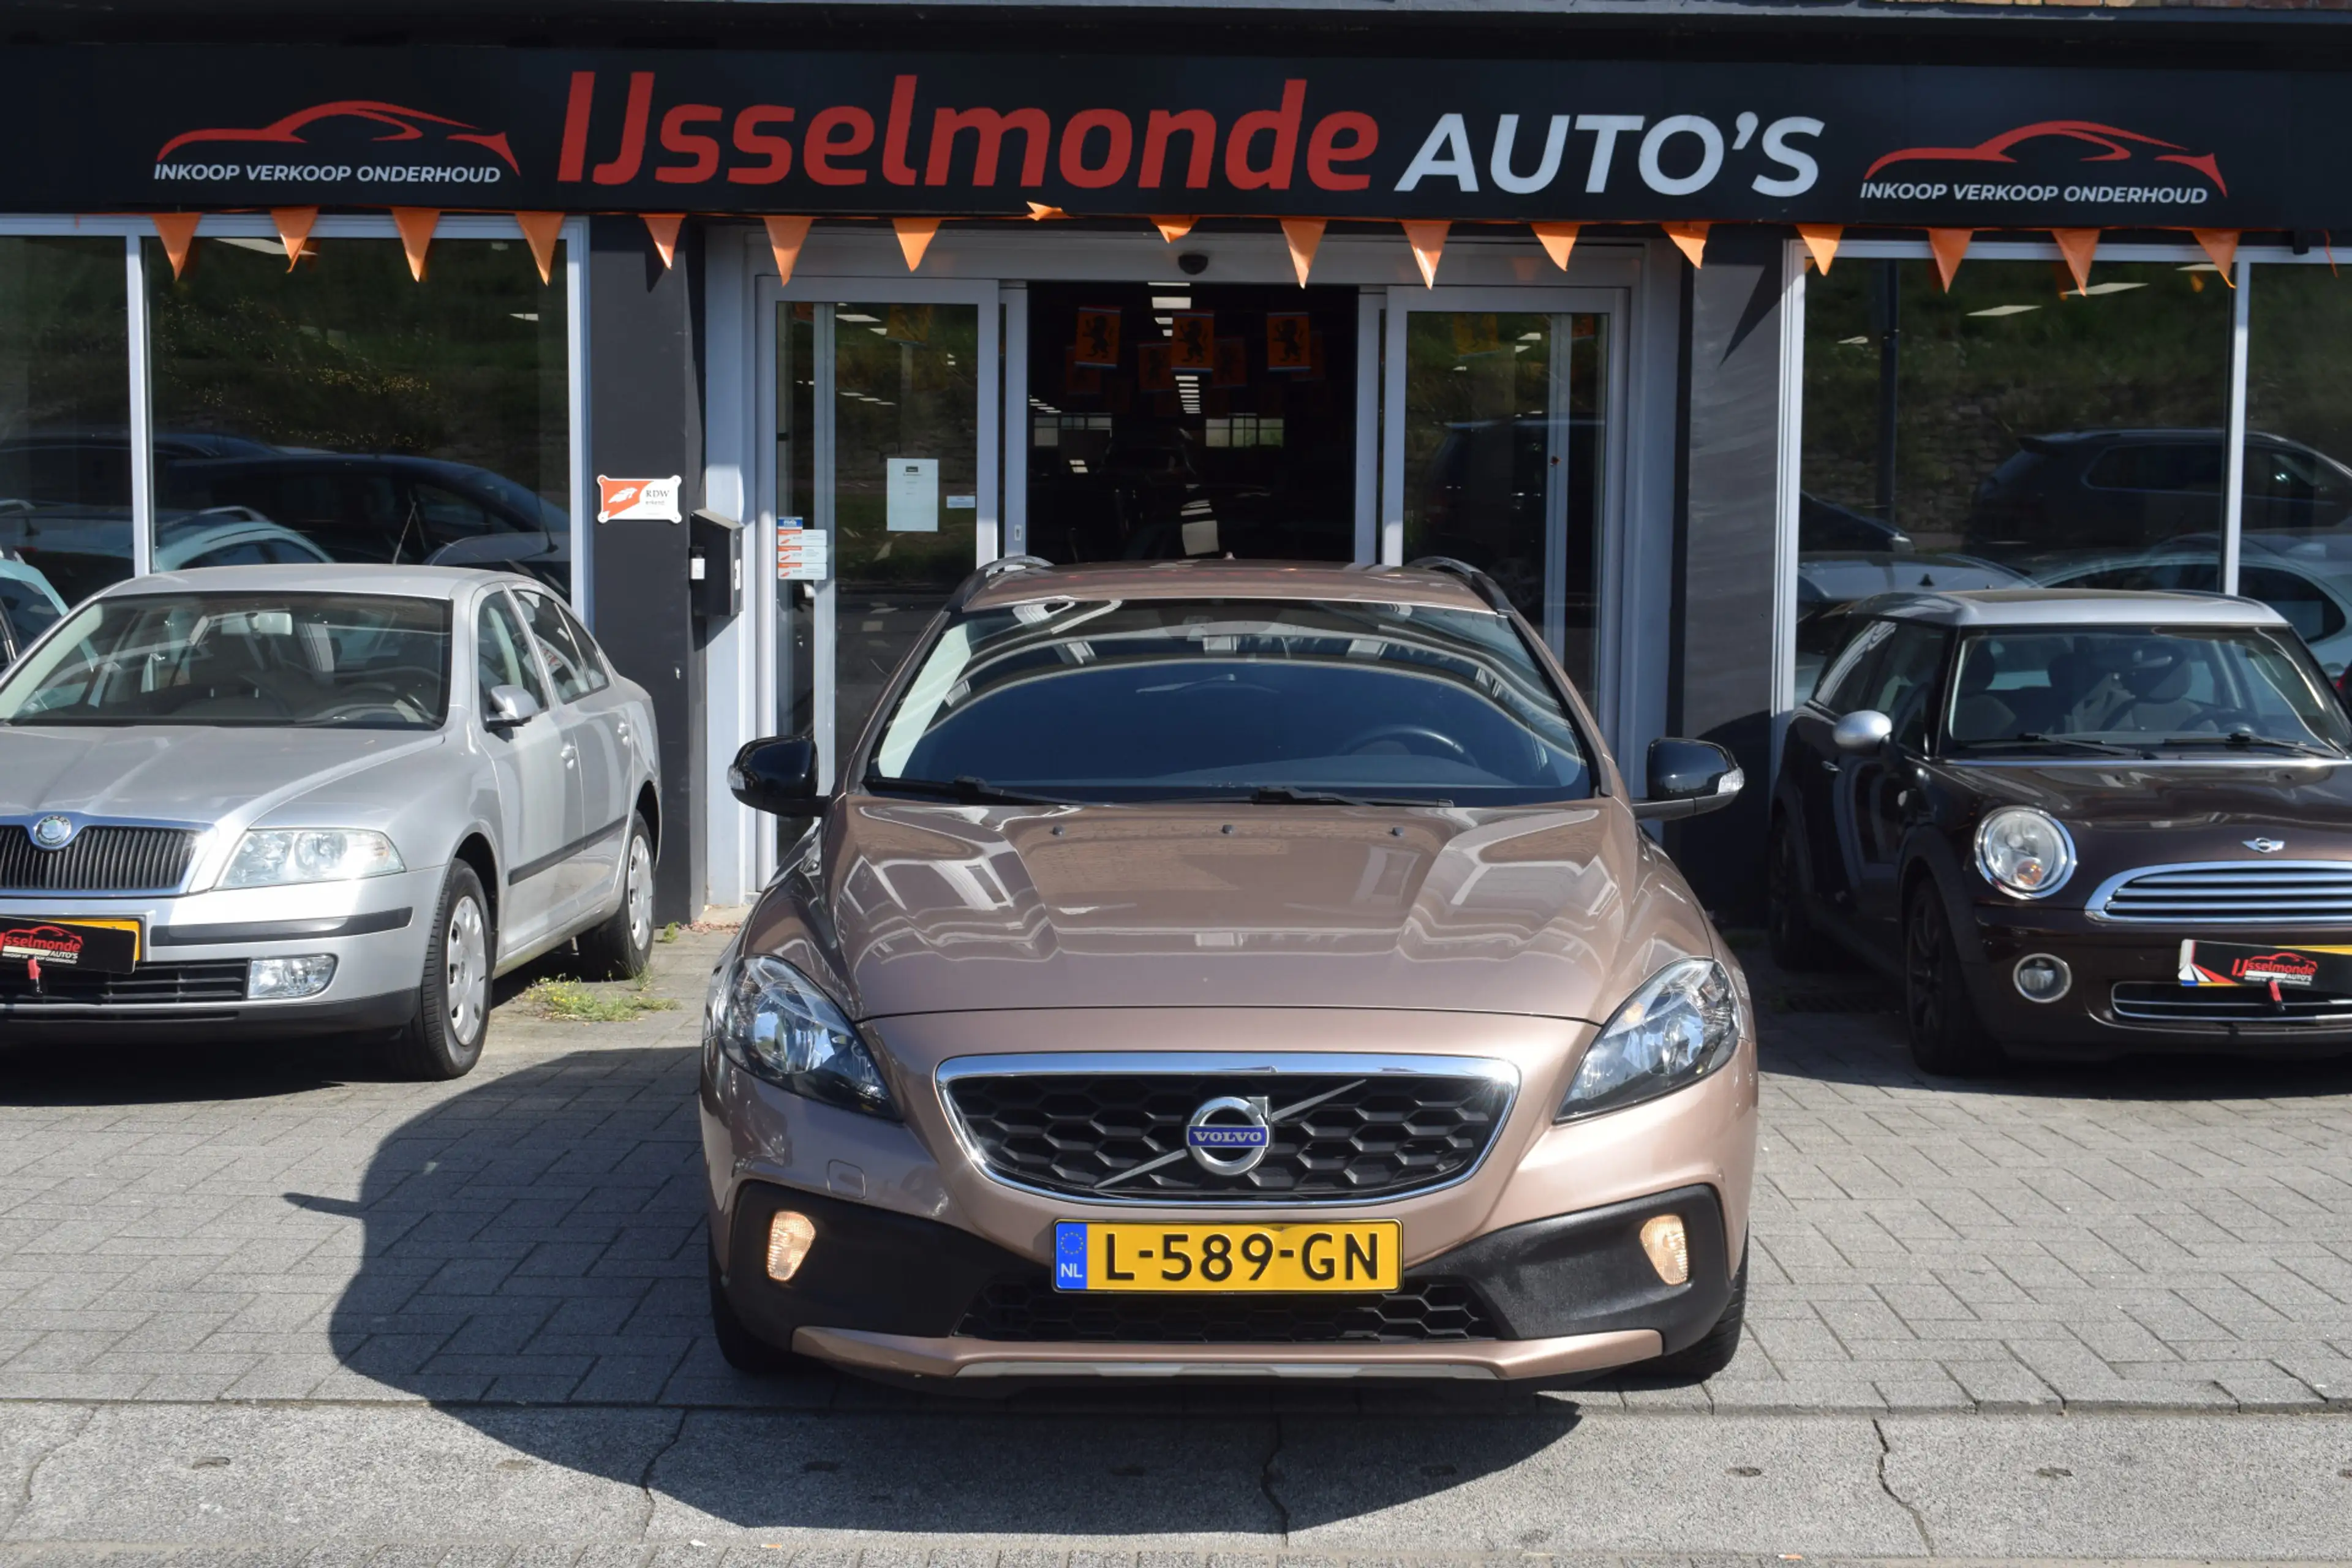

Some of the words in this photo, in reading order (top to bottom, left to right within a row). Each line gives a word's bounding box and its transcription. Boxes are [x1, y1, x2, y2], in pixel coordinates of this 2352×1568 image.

[557, 72, 1379, 191] IJsselmonde
[1394, 111, 1825, 197] AUTO'S
[154, 164, 240, 180] INKOOP
[246, 165, 352, 181] VERKOOP
[357, 166, 501, 183] ONDERHOUD
[1860, 182, 1947, 200] INKOOP
[1953, 184, 2059, 202] VERKOOP
[2064, 186, 2207, 204] ONDERHOUD
[2231, 958, 2315, 976] IJsselmonde
[1193, 1131, 1263, 1142] VOLVO
[1106, 1232, 1379, 1283] L-589-GN
[1061, 1263, 1083, 1278] NL
